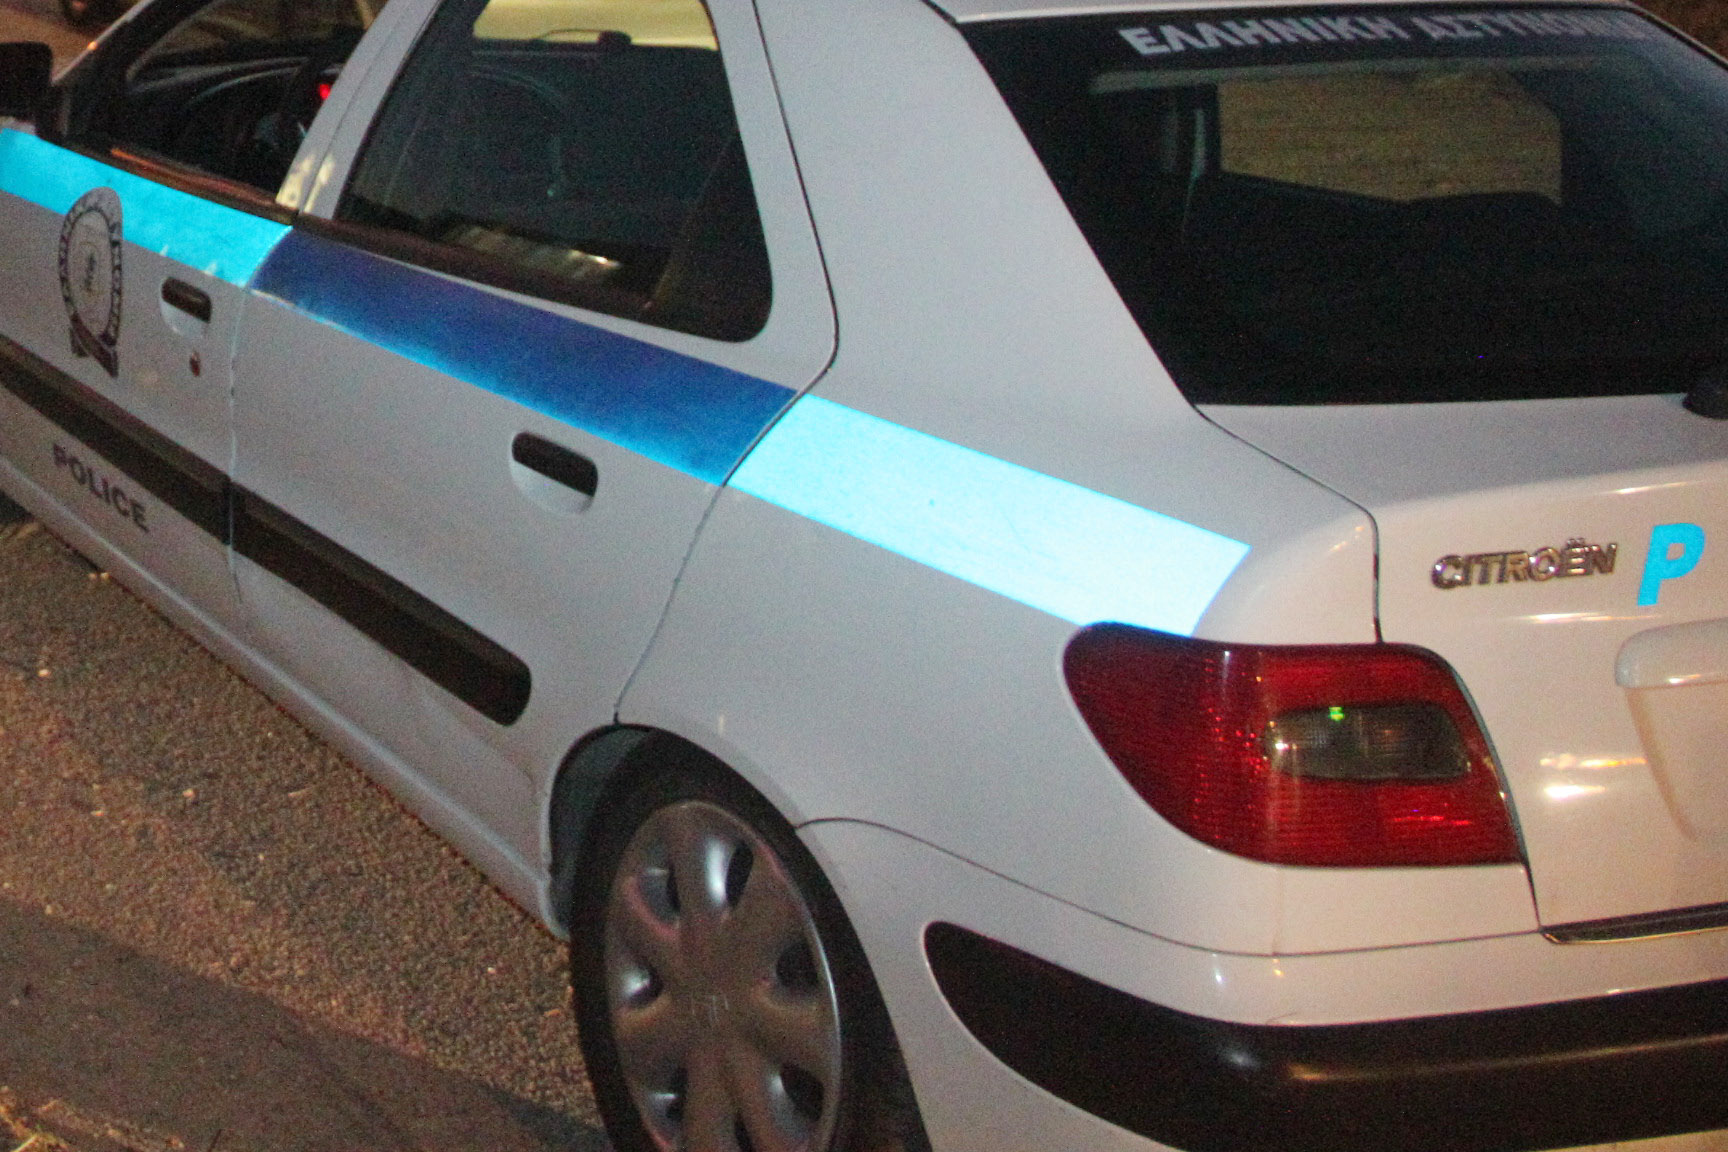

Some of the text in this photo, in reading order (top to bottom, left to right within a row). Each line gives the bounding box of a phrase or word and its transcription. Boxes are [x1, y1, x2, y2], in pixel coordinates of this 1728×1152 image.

[1119, 16, 1410, 55] ΕΛΛΗΝΙΚΗ
[53, 443, 150, 533] POLICE
[1431, 537, 1618, 589] CITROËN
[1637, 522, 1706, 607] P
